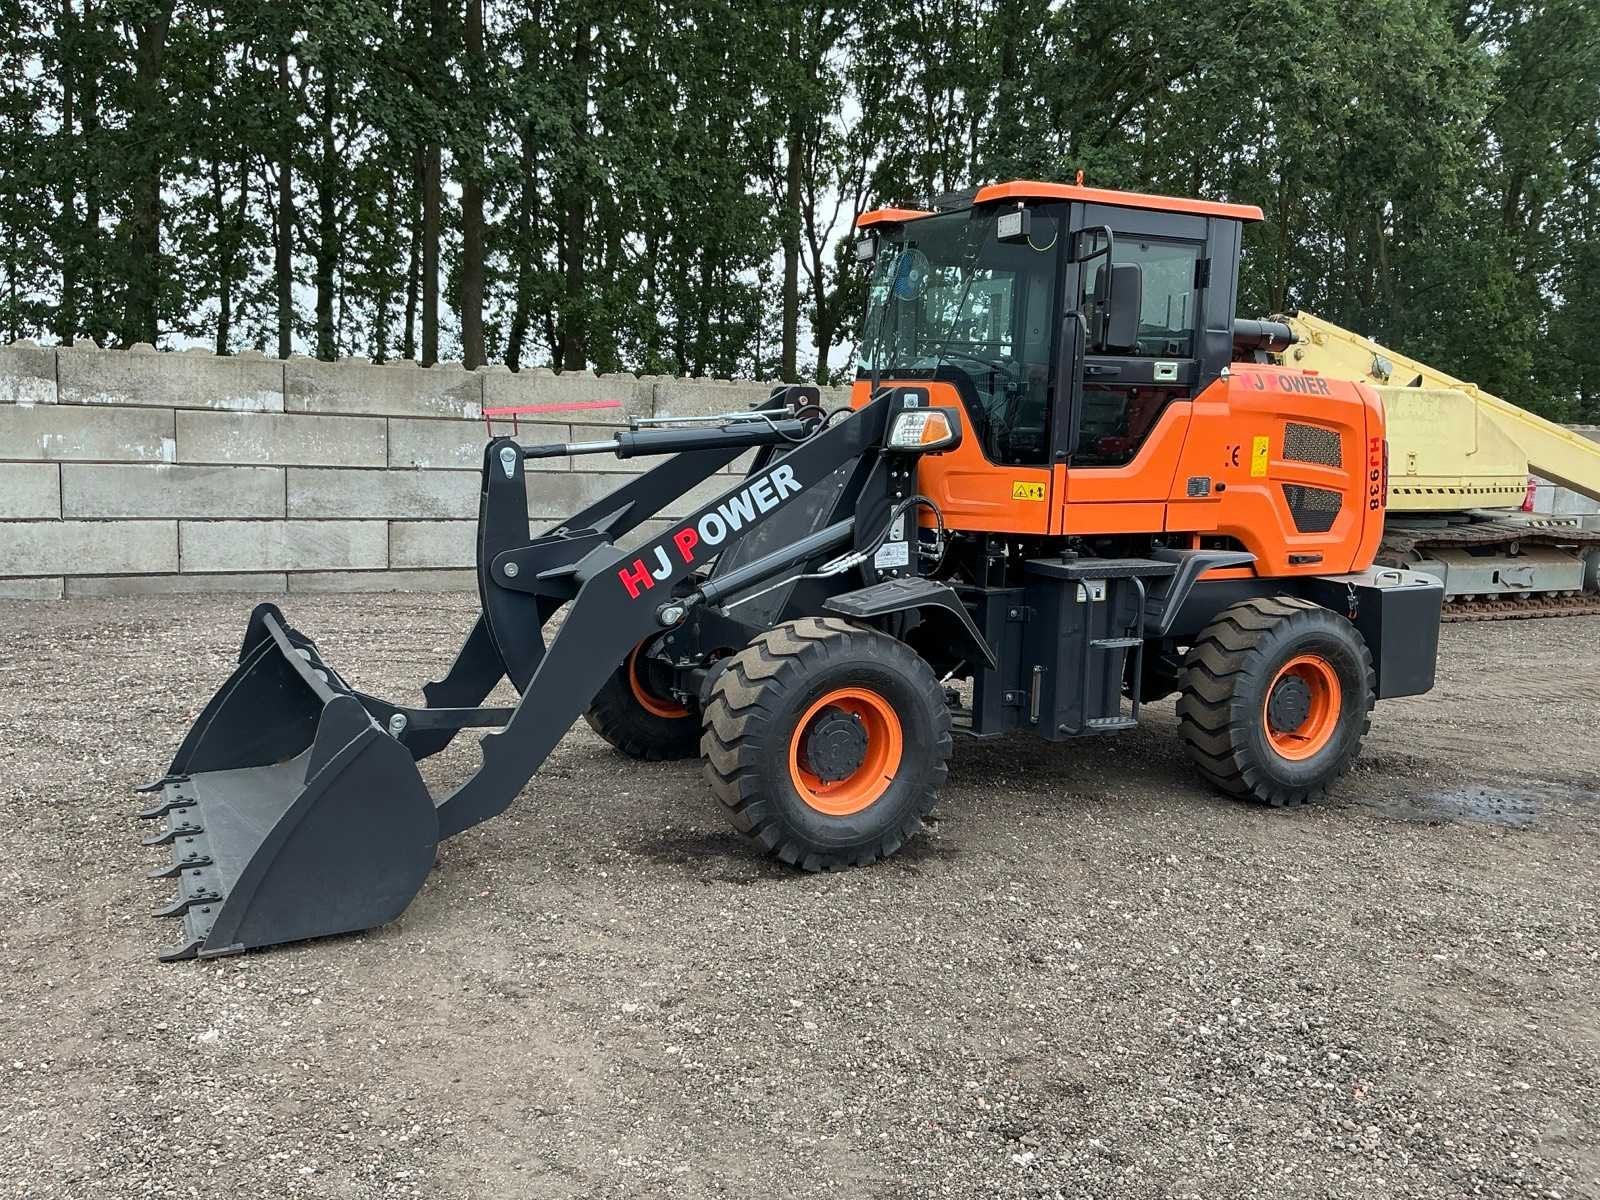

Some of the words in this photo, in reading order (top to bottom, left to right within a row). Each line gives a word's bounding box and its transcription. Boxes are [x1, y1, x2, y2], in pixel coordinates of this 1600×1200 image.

[1267, 374, 1331, 395] POWER
[1369, 436, 1380, 511] HJ938
[618, 545, 674, 599] HJ
[673, 464, 803, 563] POWER
